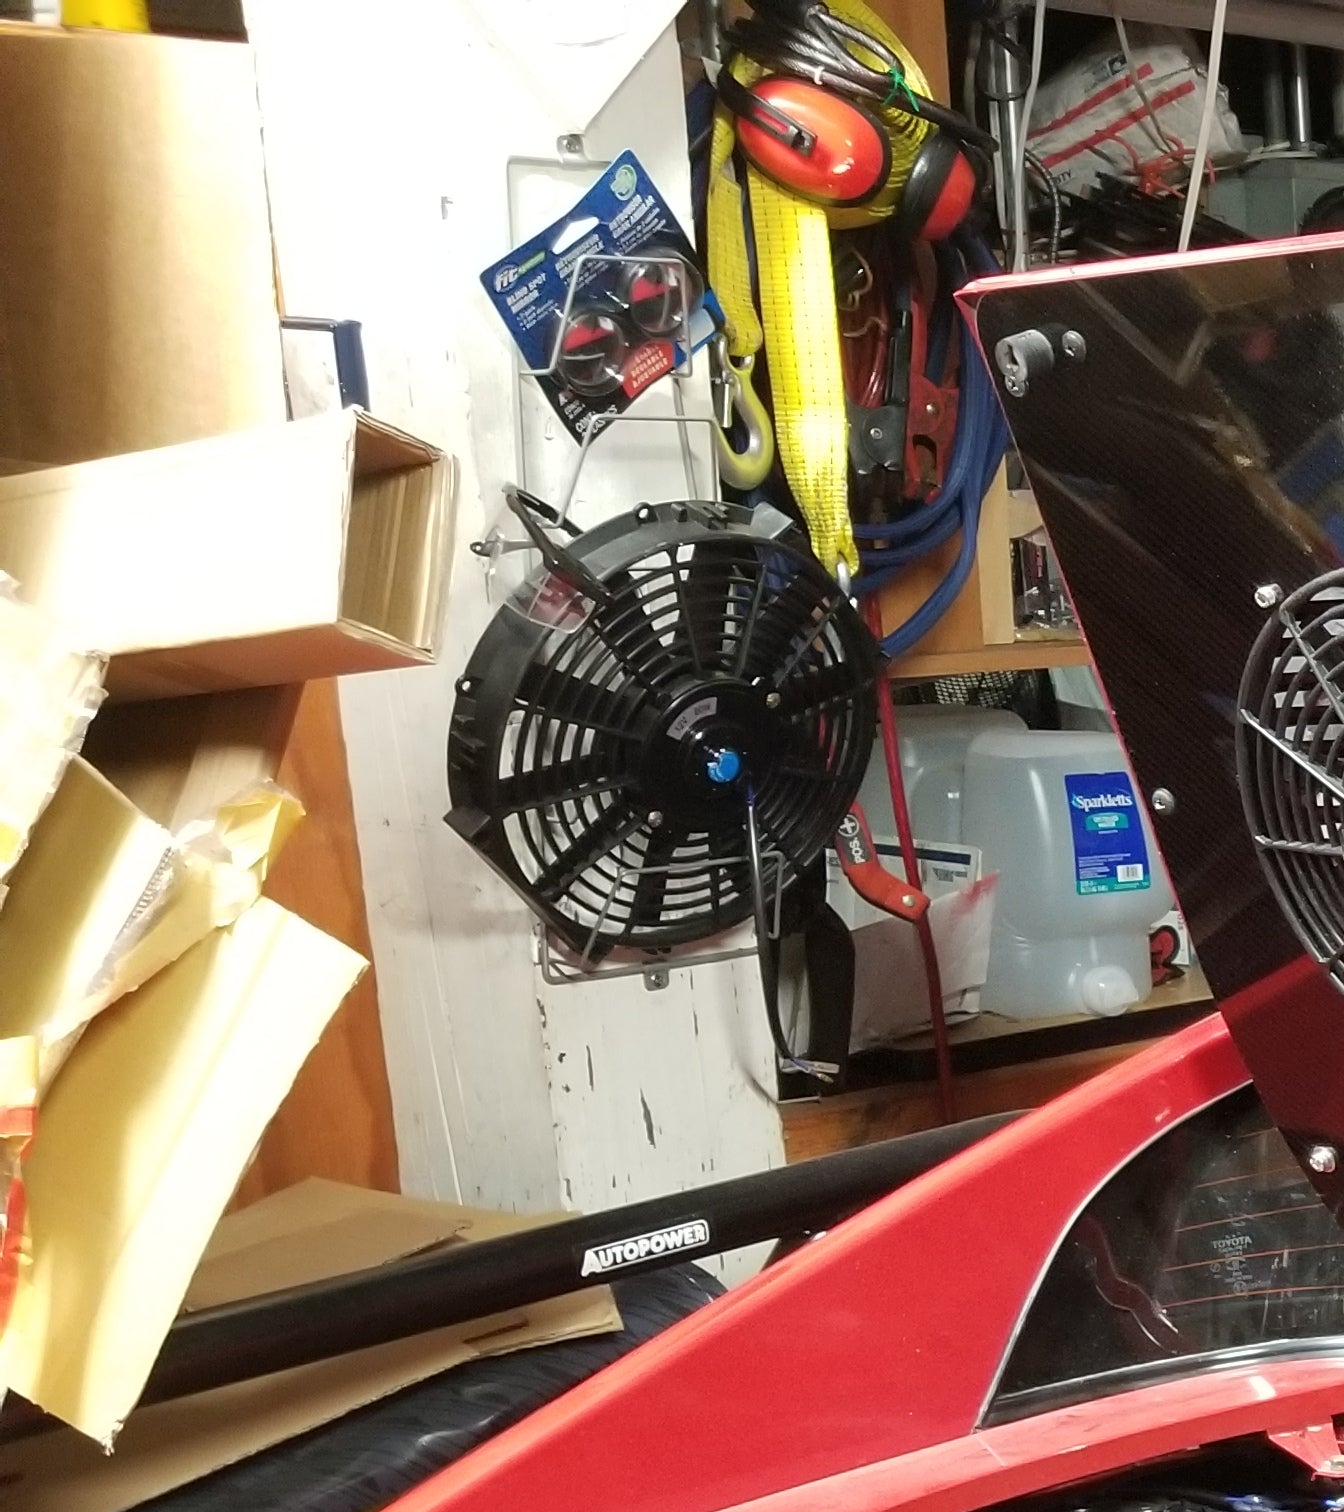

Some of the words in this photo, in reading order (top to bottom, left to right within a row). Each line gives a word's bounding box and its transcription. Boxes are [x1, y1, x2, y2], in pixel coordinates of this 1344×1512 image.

[1075, 793, 1133, 812] Sparkletts
[581, 1223, 708, 1277] AUTOPOWER
[1212, 1235, 1253, 1249] TOYOTA
